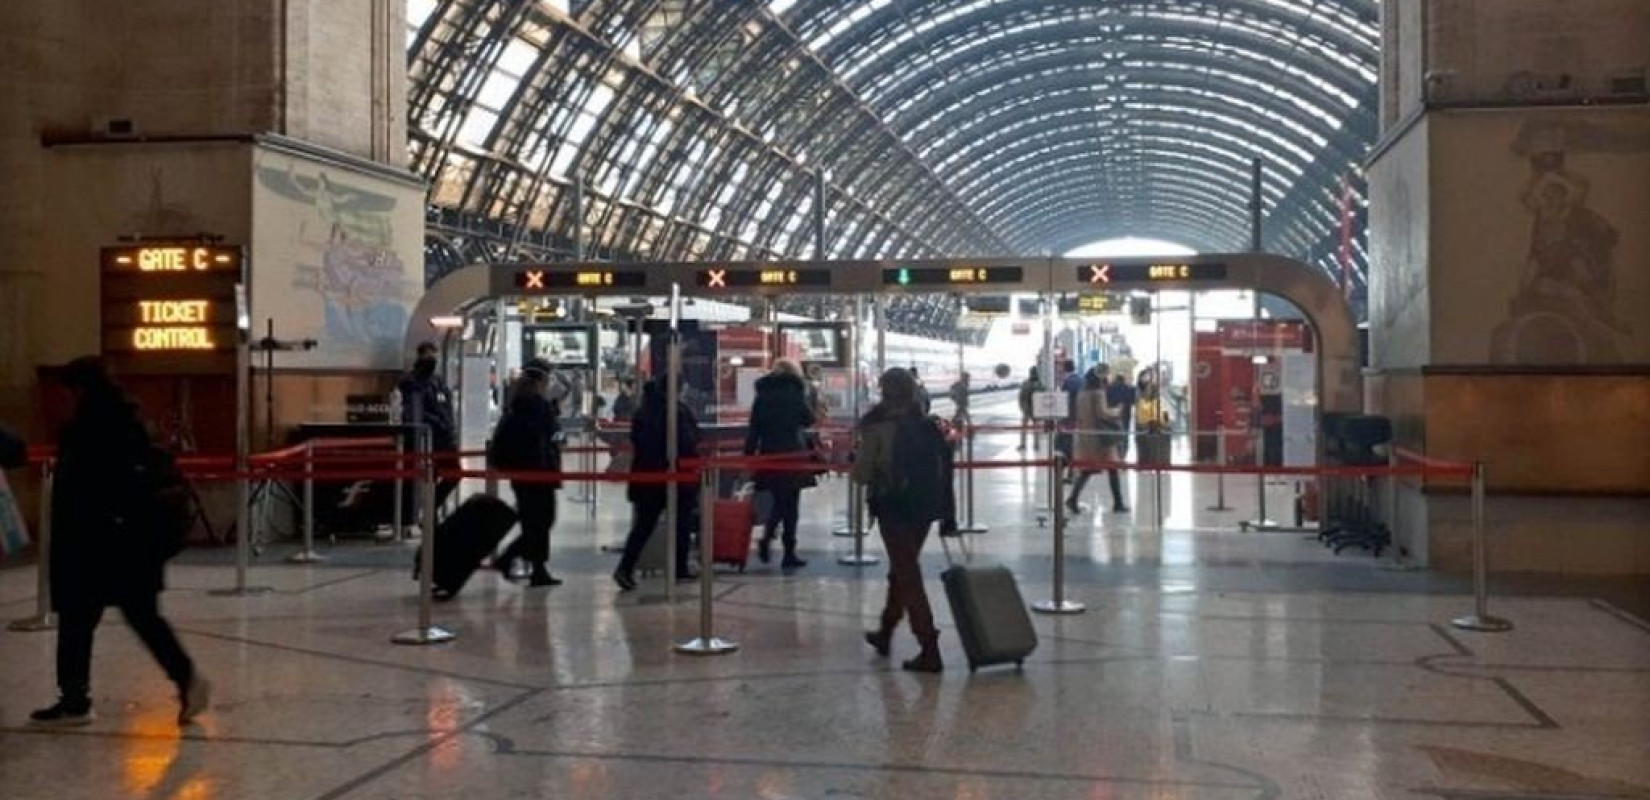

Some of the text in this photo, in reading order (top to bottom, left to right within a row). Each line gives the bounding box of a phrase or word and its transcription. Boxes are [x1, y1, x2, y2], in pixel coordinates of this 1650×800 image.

[138, 248, 187, 271] GATE
[194, 248, 208, 270] C
[761, 271, 797, 283] GATE C
[951, 269, 987, 280] GATE C
[1149, 266, 1190, 277] GATE C
[577, 273, 613, 285] GATE C
[139, 301, 208, 323] TICKET
[134, 327, 215, 349] CONTROL
